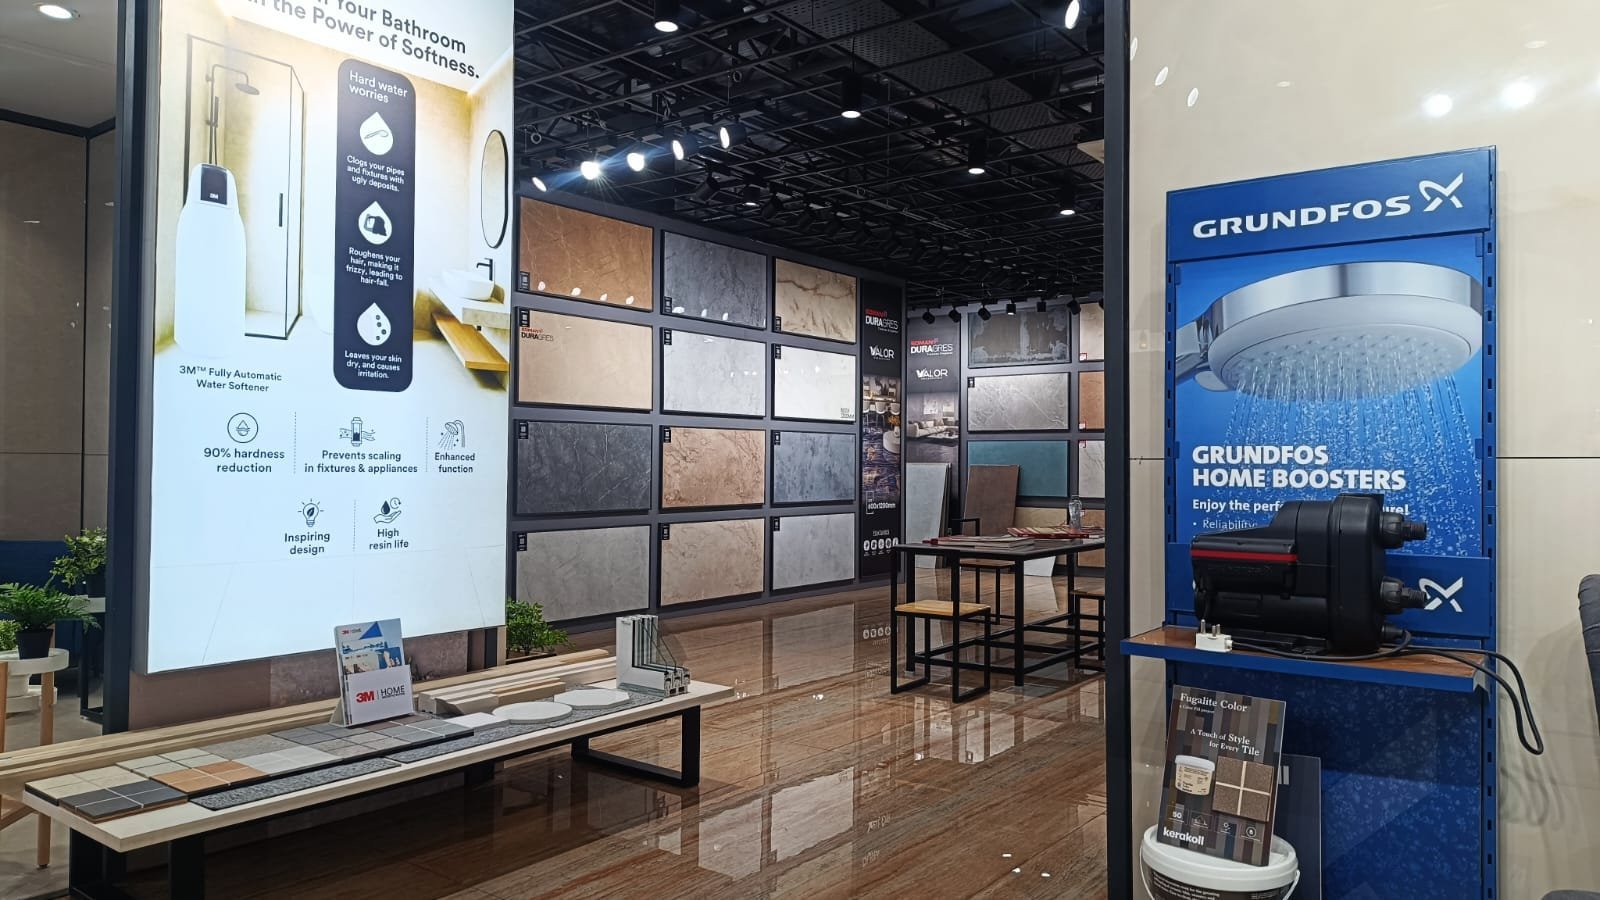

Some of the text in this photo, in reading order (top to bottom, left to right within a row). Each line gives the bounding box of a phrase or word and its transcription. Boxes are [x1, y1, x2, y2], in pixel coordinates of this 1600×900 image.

[338, 0, 467, 54] Your Bathroom
[273, 0, 480, 79] the Power of Softness.
[349, 70, 408, 98] Hard water
[349, 84, 389, 104] worries
[347, 155, 405, 177] Clogs your pipes
[347, 165, 405, 185] and fixtures with
[351, 175, 400, 192] ugly deposits.
[1192, 195, 1411, 239] GRUNDFOS
[348, 246, 401, 263] Roughens your
[350, 255, 400, 272] hair, making it
[346, 264, 403, 281] frizzy, leading to
[360, 275, 389, 287] hair-fall.
[865, 315, 899, 330] DURAGRES
[869, 345, 895, 359] VALOR
[910, 343, 953, 354] DURAGRES
[344, 350, 402, 363] Leaves your skin
[346, 360, 400, 371] dry, and causes
[208, 367, 232, 379] Fully
[233, 370, 282, 381] Automatic
[357, 368, 390, 379] irritation.
[916, 368, 949, 378] VALOR
[196, 379, 269, 392] Water Softener
[203, 447, 285, 459] 90% hardness
[321, 450, 402, 463] Prevents scaling
[434, 452, 475, 462] Enhanced
[1192, 445, 1329, 466] GRUNDFOS
[216, 462, 272, 473] reduction
[304, 463, 418, 475] in fixtures & appliances
[438, 463, 474, 474] function
[1192, 468, 1407, 492] HOME BOOSTERS
[1192, 499, 1226, 513] Enjoy
[1229, 499, 1251, 511] the
[284, 532, 331, 544] Inspiring
[377, 528, 399, 540] High
[289, 544, 325, 556] design
[369, 539, 409, 550] resin life
[356, 690, 375, 703] 3M
[380, 685, 405, 697] HOME
[1180, 692, 1218, 707] Fugalite
[1220, 699, 1248, 712] Color
[1197, 729, 1218, 739] Touch
[1218, 733, 1227, 741] of
[1228, 733, 1251, 746] Style
[1209, 740, 1260, 756] for Every Tile
[1163, 826, 1205, 846] kerakoll
